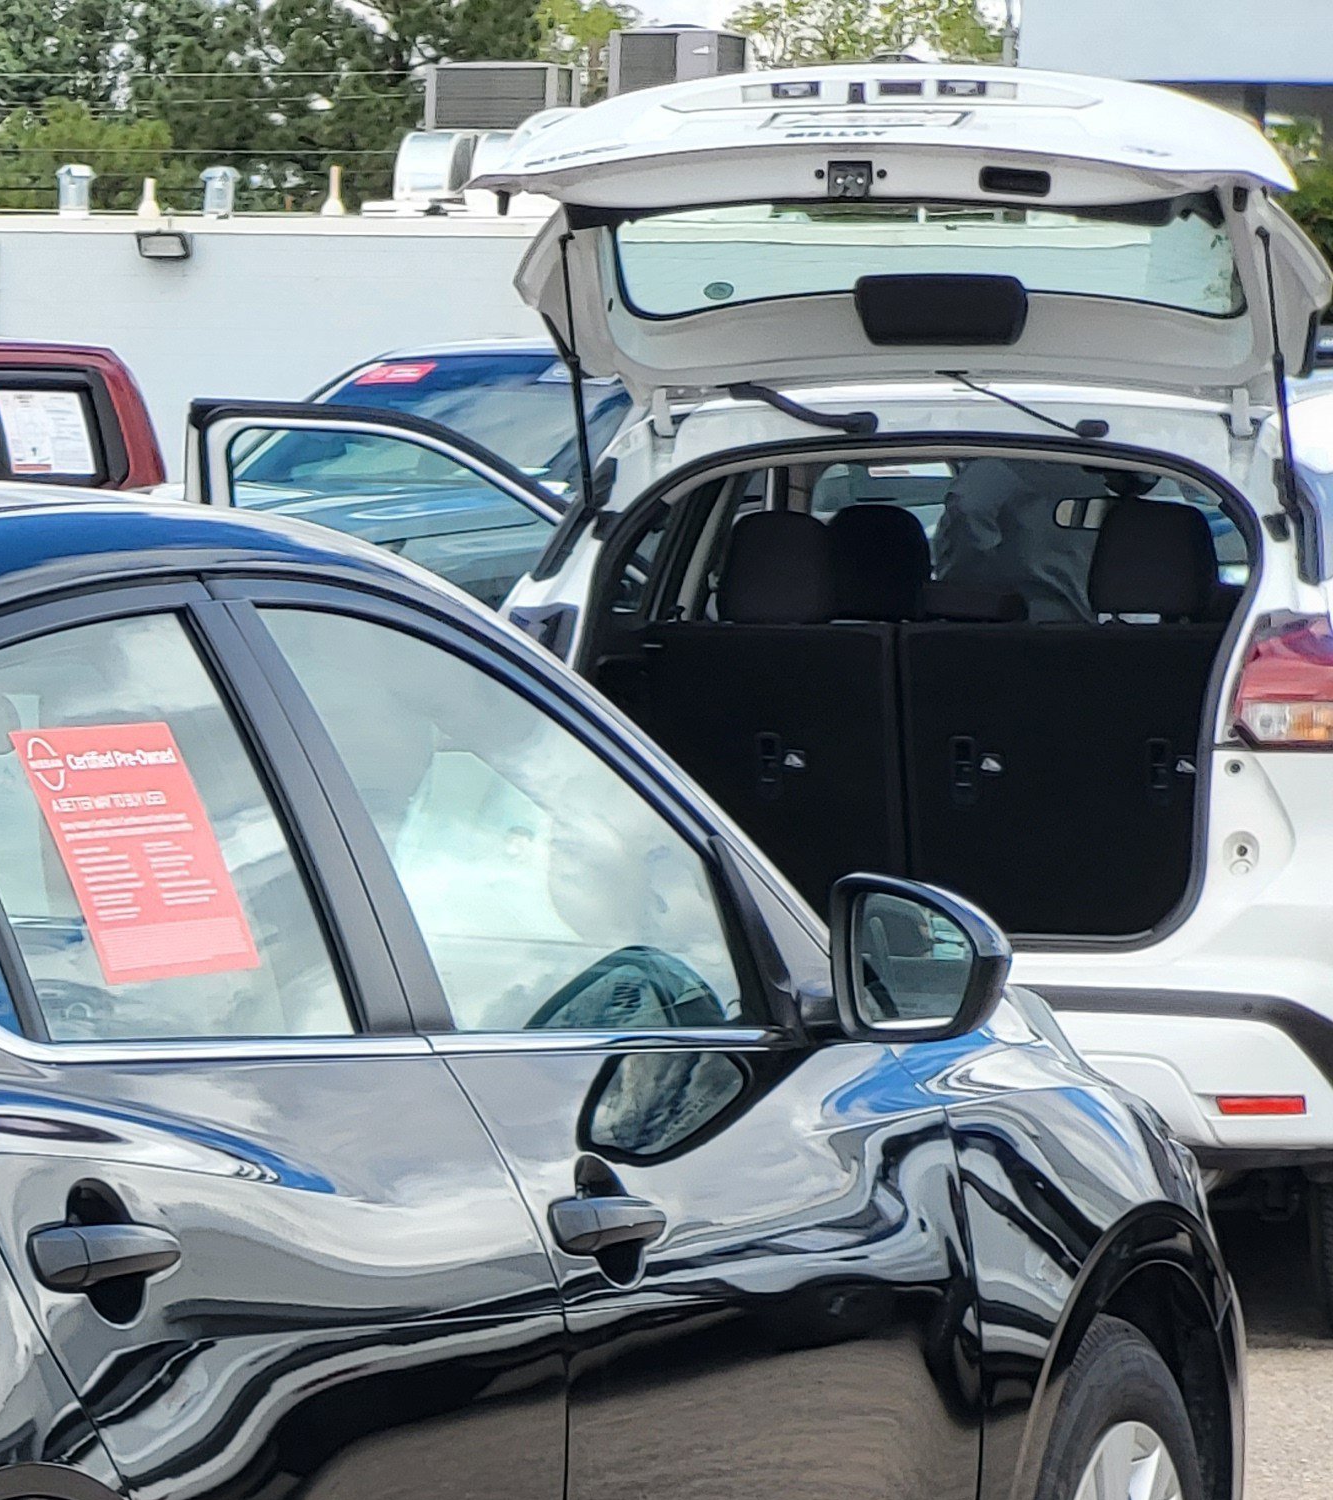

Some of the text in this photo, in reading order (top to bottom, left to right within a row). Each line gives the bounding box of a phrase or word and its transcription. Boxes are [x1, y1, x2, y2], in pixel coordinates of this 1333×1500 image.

[785, 130, 887, 138] MELLOY
[65, 747, 178, 771] Certified Pre-Owned
